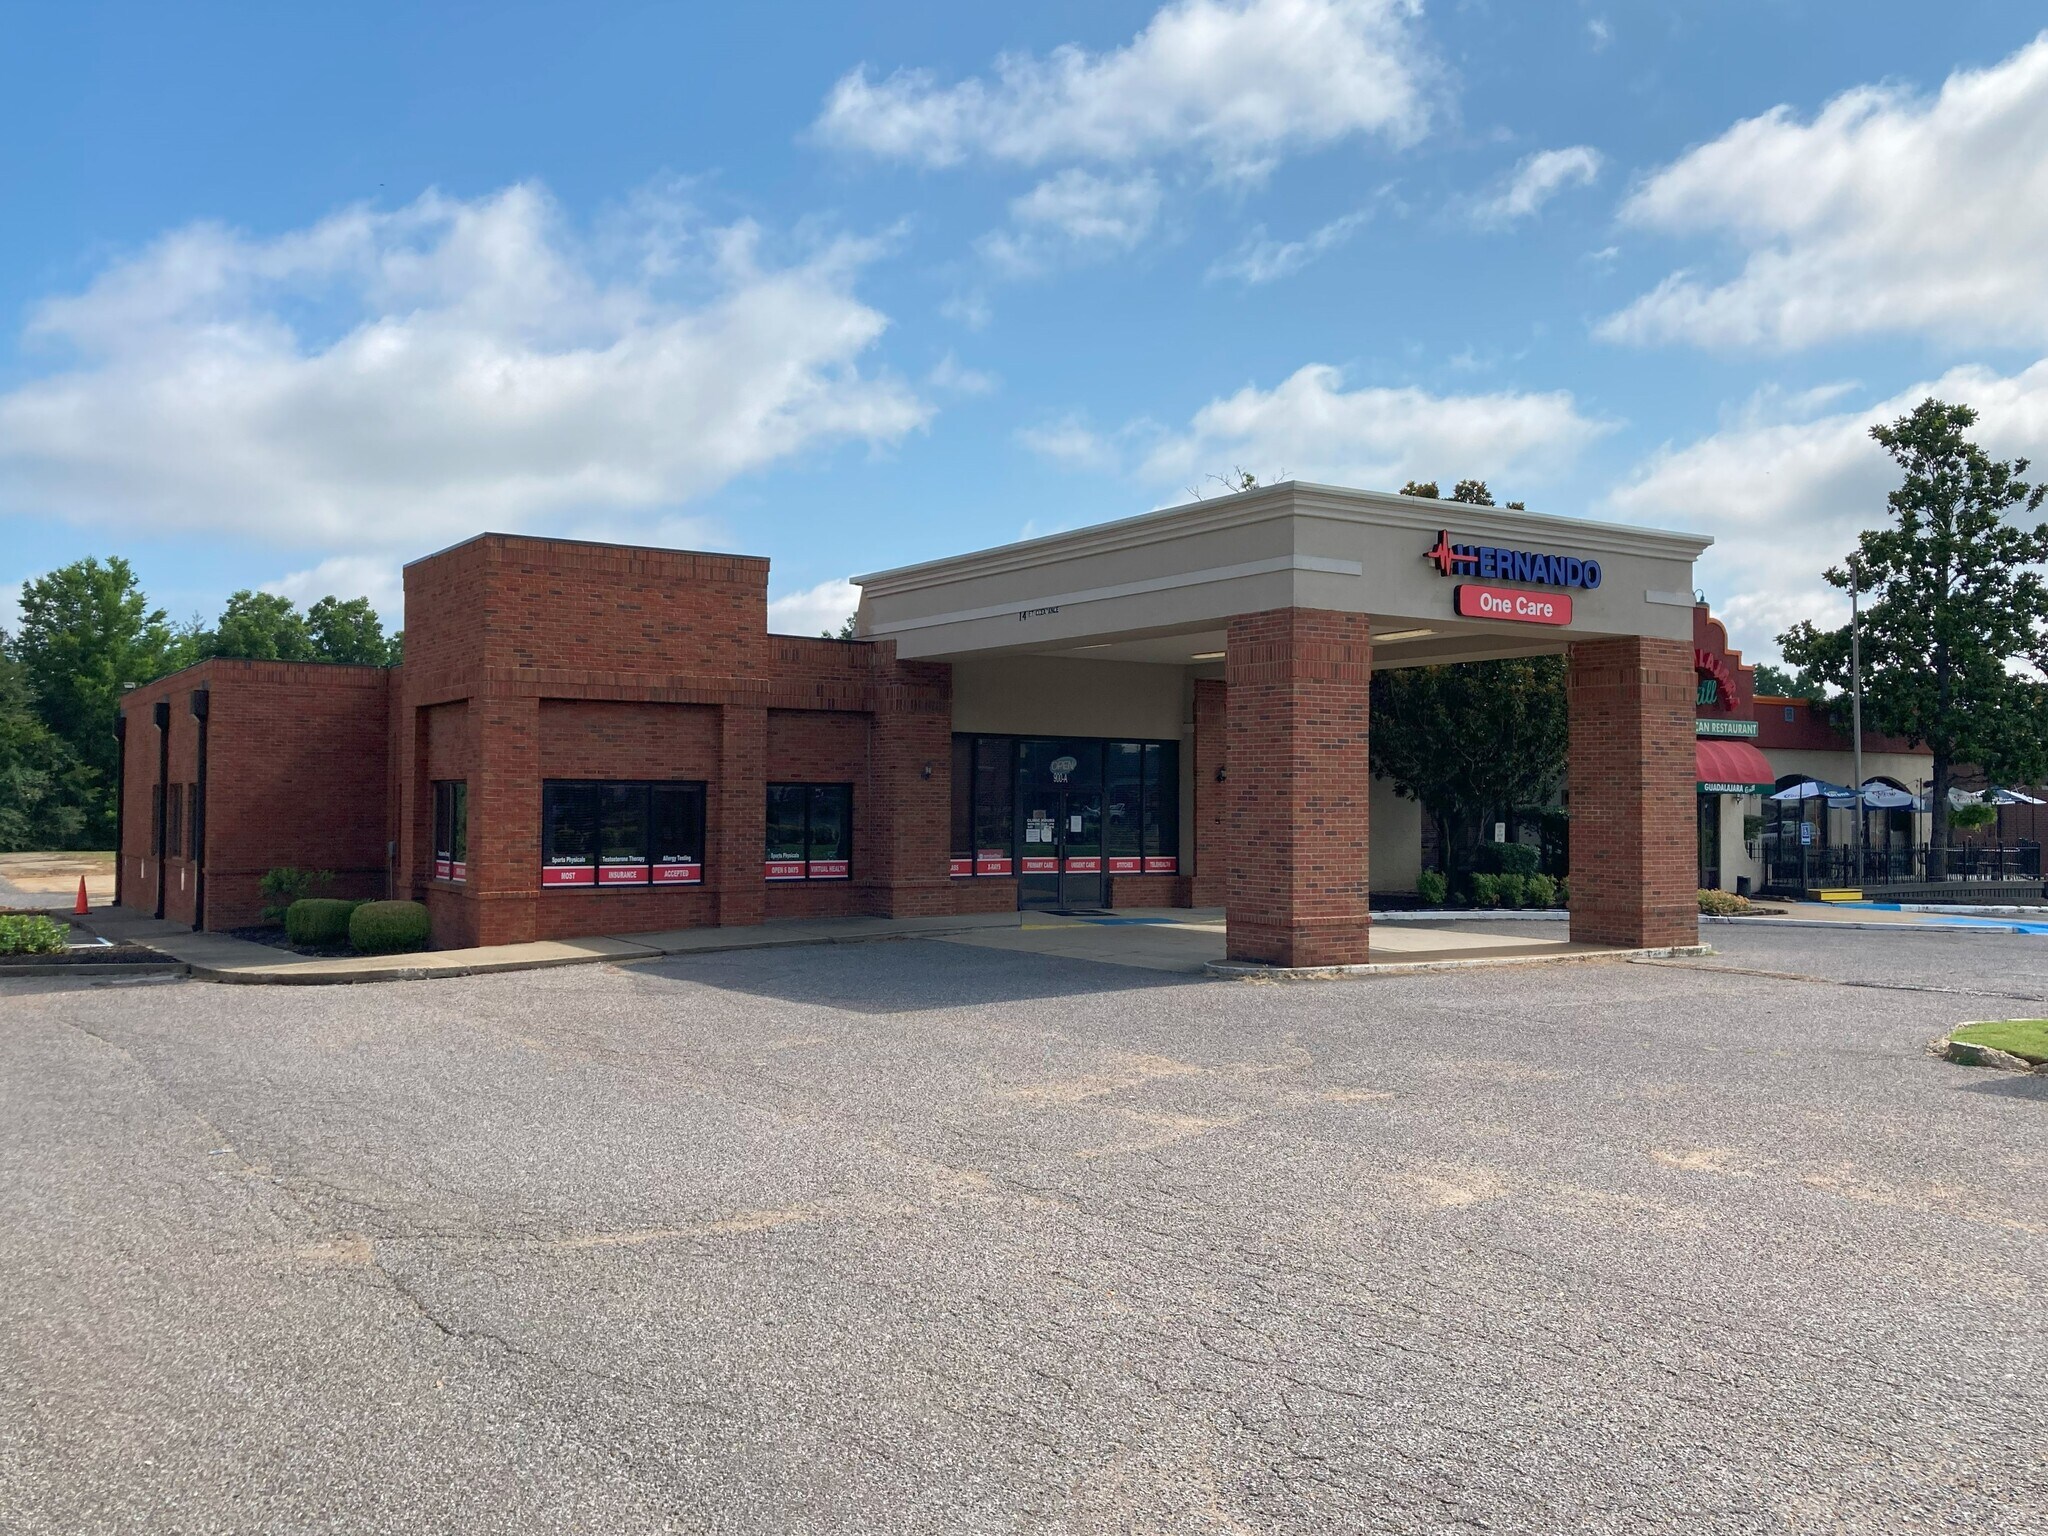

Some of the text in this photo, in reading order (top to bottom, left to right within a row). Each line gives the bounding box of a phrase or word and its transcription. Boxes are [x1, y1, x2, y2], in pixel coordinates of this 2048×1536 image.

[1453, 544, 1602, 589] HERNANDO
[1480, 592, 1553, 617] One Care
[1711, 722, 1757, 735] RESTAURANT
[1052, 760, 1075, 771] OPEN
[1704, 783, 1744, 793] GUADALAJARA
[566, 856, 586, 864] Physicals
[629, 855, 645, 863] Therapy
[677, 854, 692, 862] Testing
[664, 869, 689, 878] ACCEPTED
[771, 866, 784, 874] OPEN
[788, 866, 799, 874] DAYS
[810, 865, 846, 873] VIRTUAL HEALTH
[561, 872, 576, 880] MOST
[608, 870, 637, 879] INSURANCE
